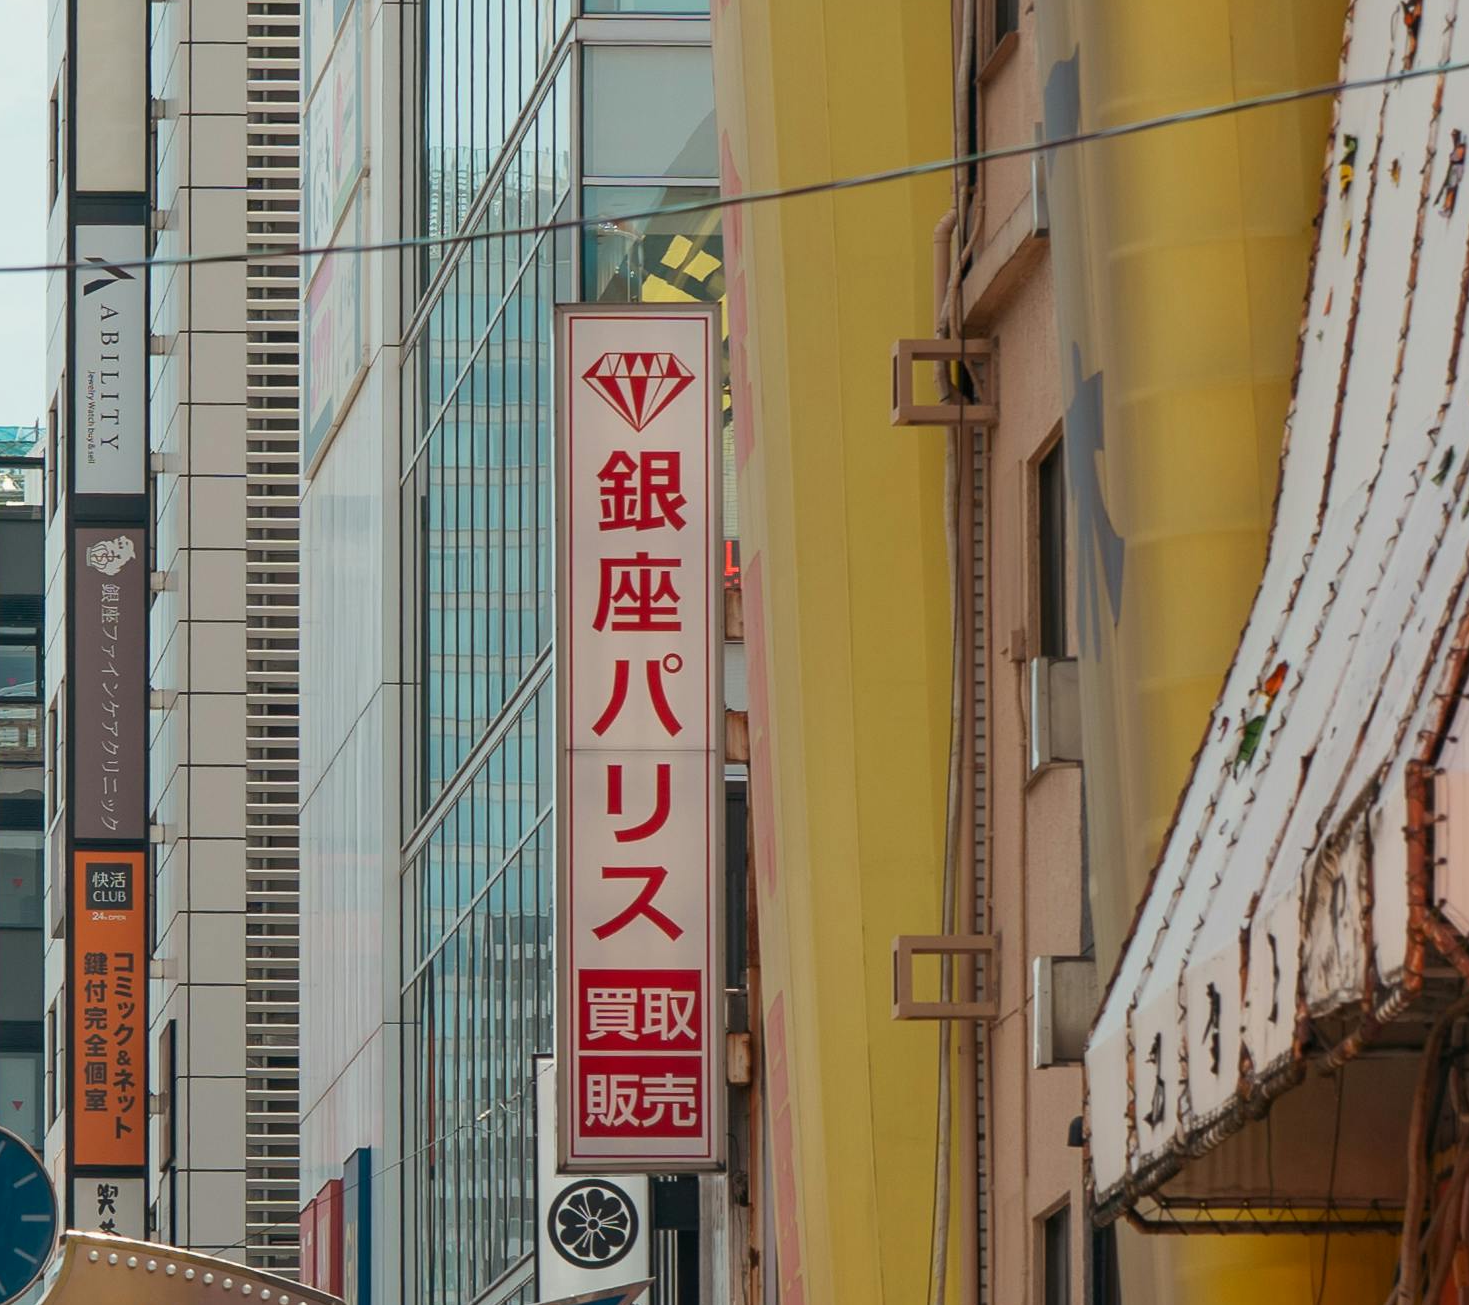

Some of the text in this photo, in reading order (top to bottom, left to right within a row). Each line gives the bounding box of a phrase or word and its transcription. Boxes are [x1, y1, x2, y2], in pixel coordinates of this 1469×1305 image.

[100, 302, 120, 451] ABILITY
[101, 583, 120, 832] 銀座ファインケアクリニック
[592, 449, 687, 942] 銀座パリス
[92, 871, 127, 889] 快活
[92, 889, 127, 903] CLUB
[84, 952, 108, 1113] 鍵付完全個室
[113, 952, 135, 1140] コミック&ネット
[585, 988, 698, 1042] 買取
[585, 1073, 699, 1128] 販売
